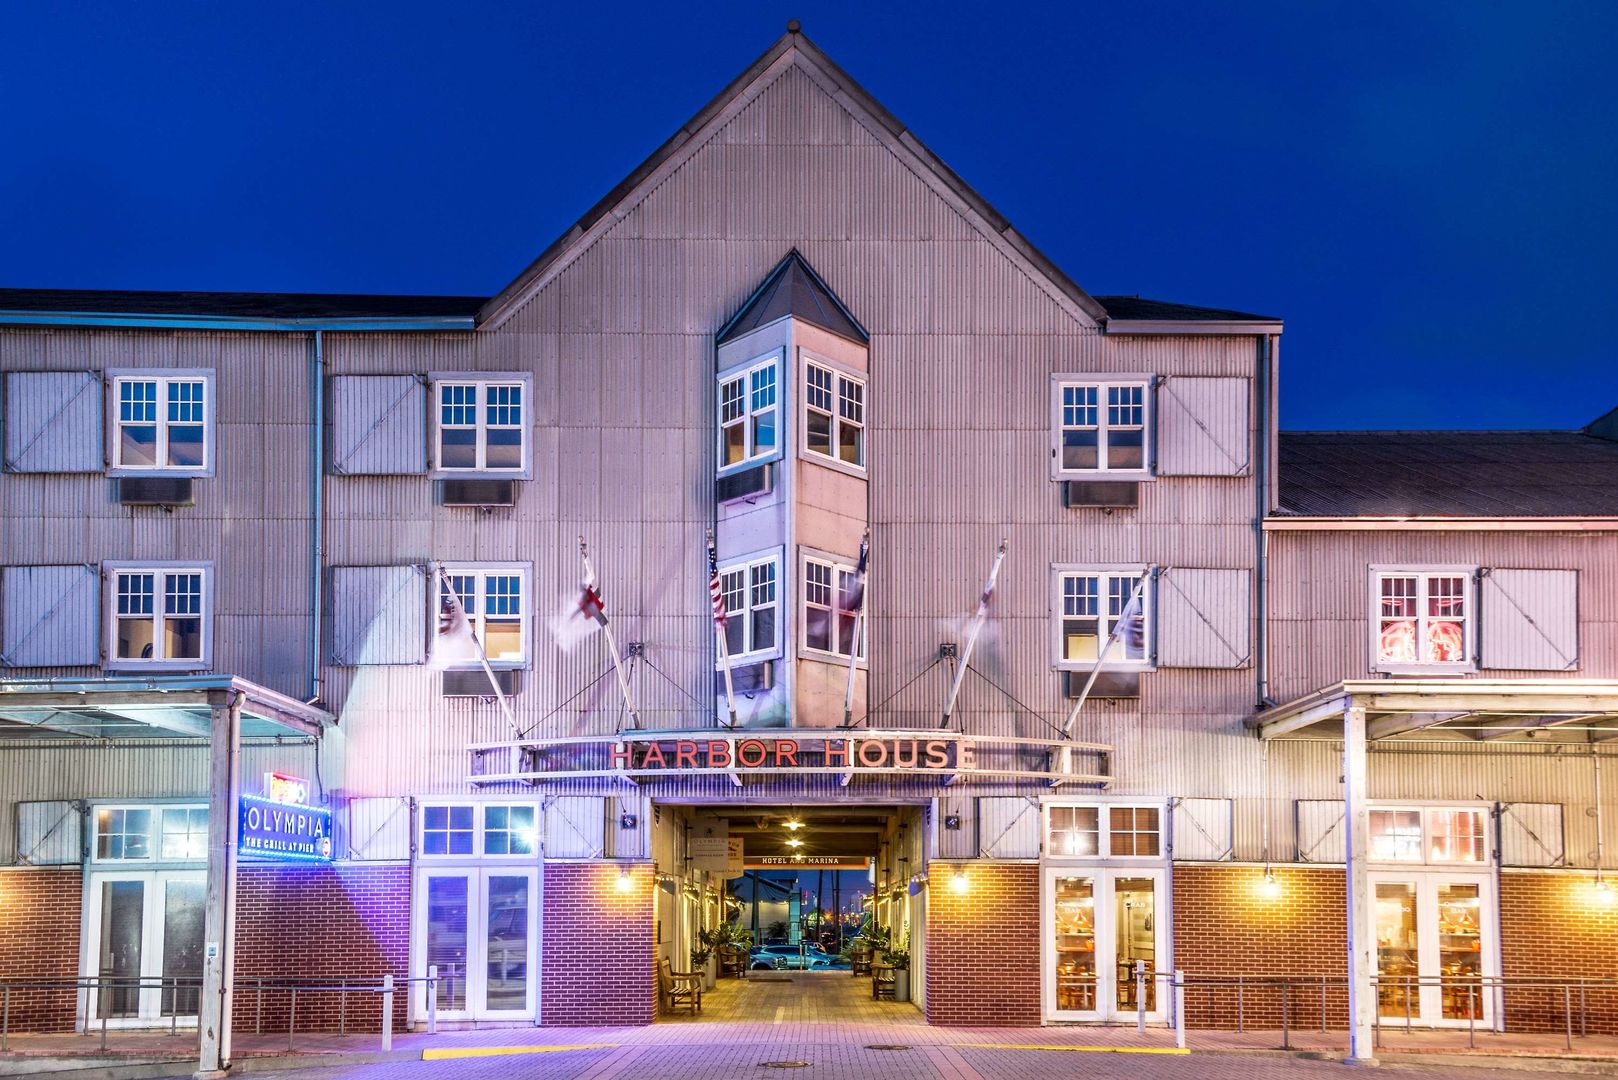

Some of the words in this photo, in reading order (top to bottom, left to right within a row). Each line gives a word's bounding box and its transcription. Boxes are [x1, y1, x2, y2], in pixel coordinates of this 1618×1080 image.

[609, 739, 799, 769] HARBOR
[824, 739, 977, 769] HOUSE
[248, 806, 324, 838] OLYMPIA
[246, 836, 262, 848] THE
[263, 839, 286, 851] GRILL
[288, 842, 297, 852] AT
[298, 843, 314, 853] PIER
